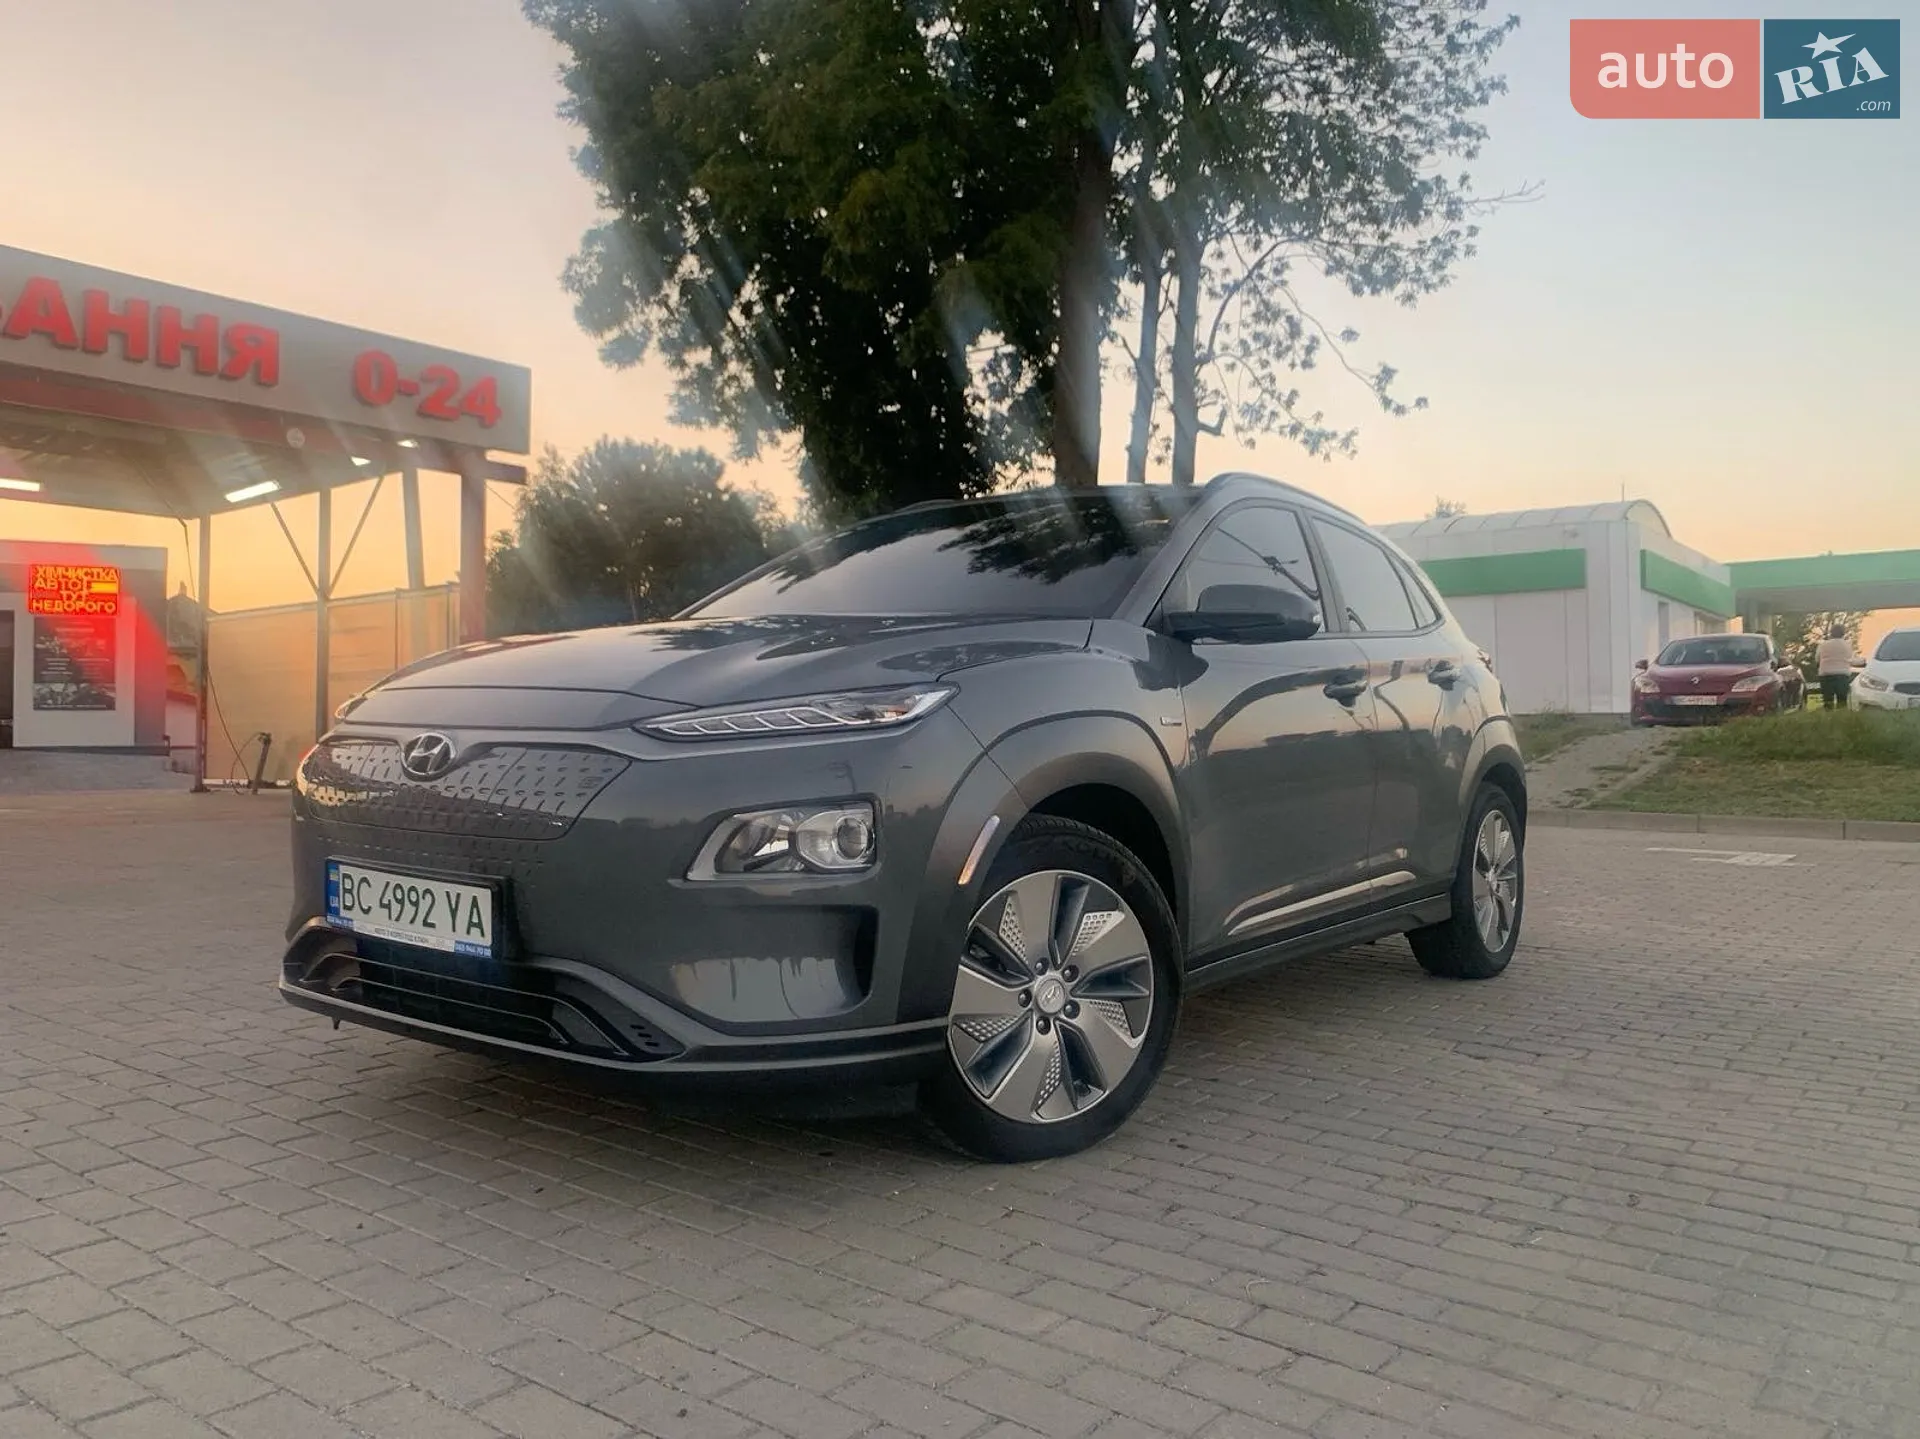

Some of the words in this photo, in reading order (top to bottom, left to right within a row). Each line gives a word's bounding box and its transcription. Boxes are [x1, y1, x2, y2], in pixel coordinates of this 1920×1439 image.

[0, 275, 281, 387] АННЯ
[353, 348, 503, 428] 0-24
[36, 566, 118, 581] ХІМЧИСТКА
[32, 599, 117, 614] НЕДОРОГО
[341, 872, 372, 915] BC
[379, 880, 437, 929] 4992
[445, 890, 486, 938] YA
